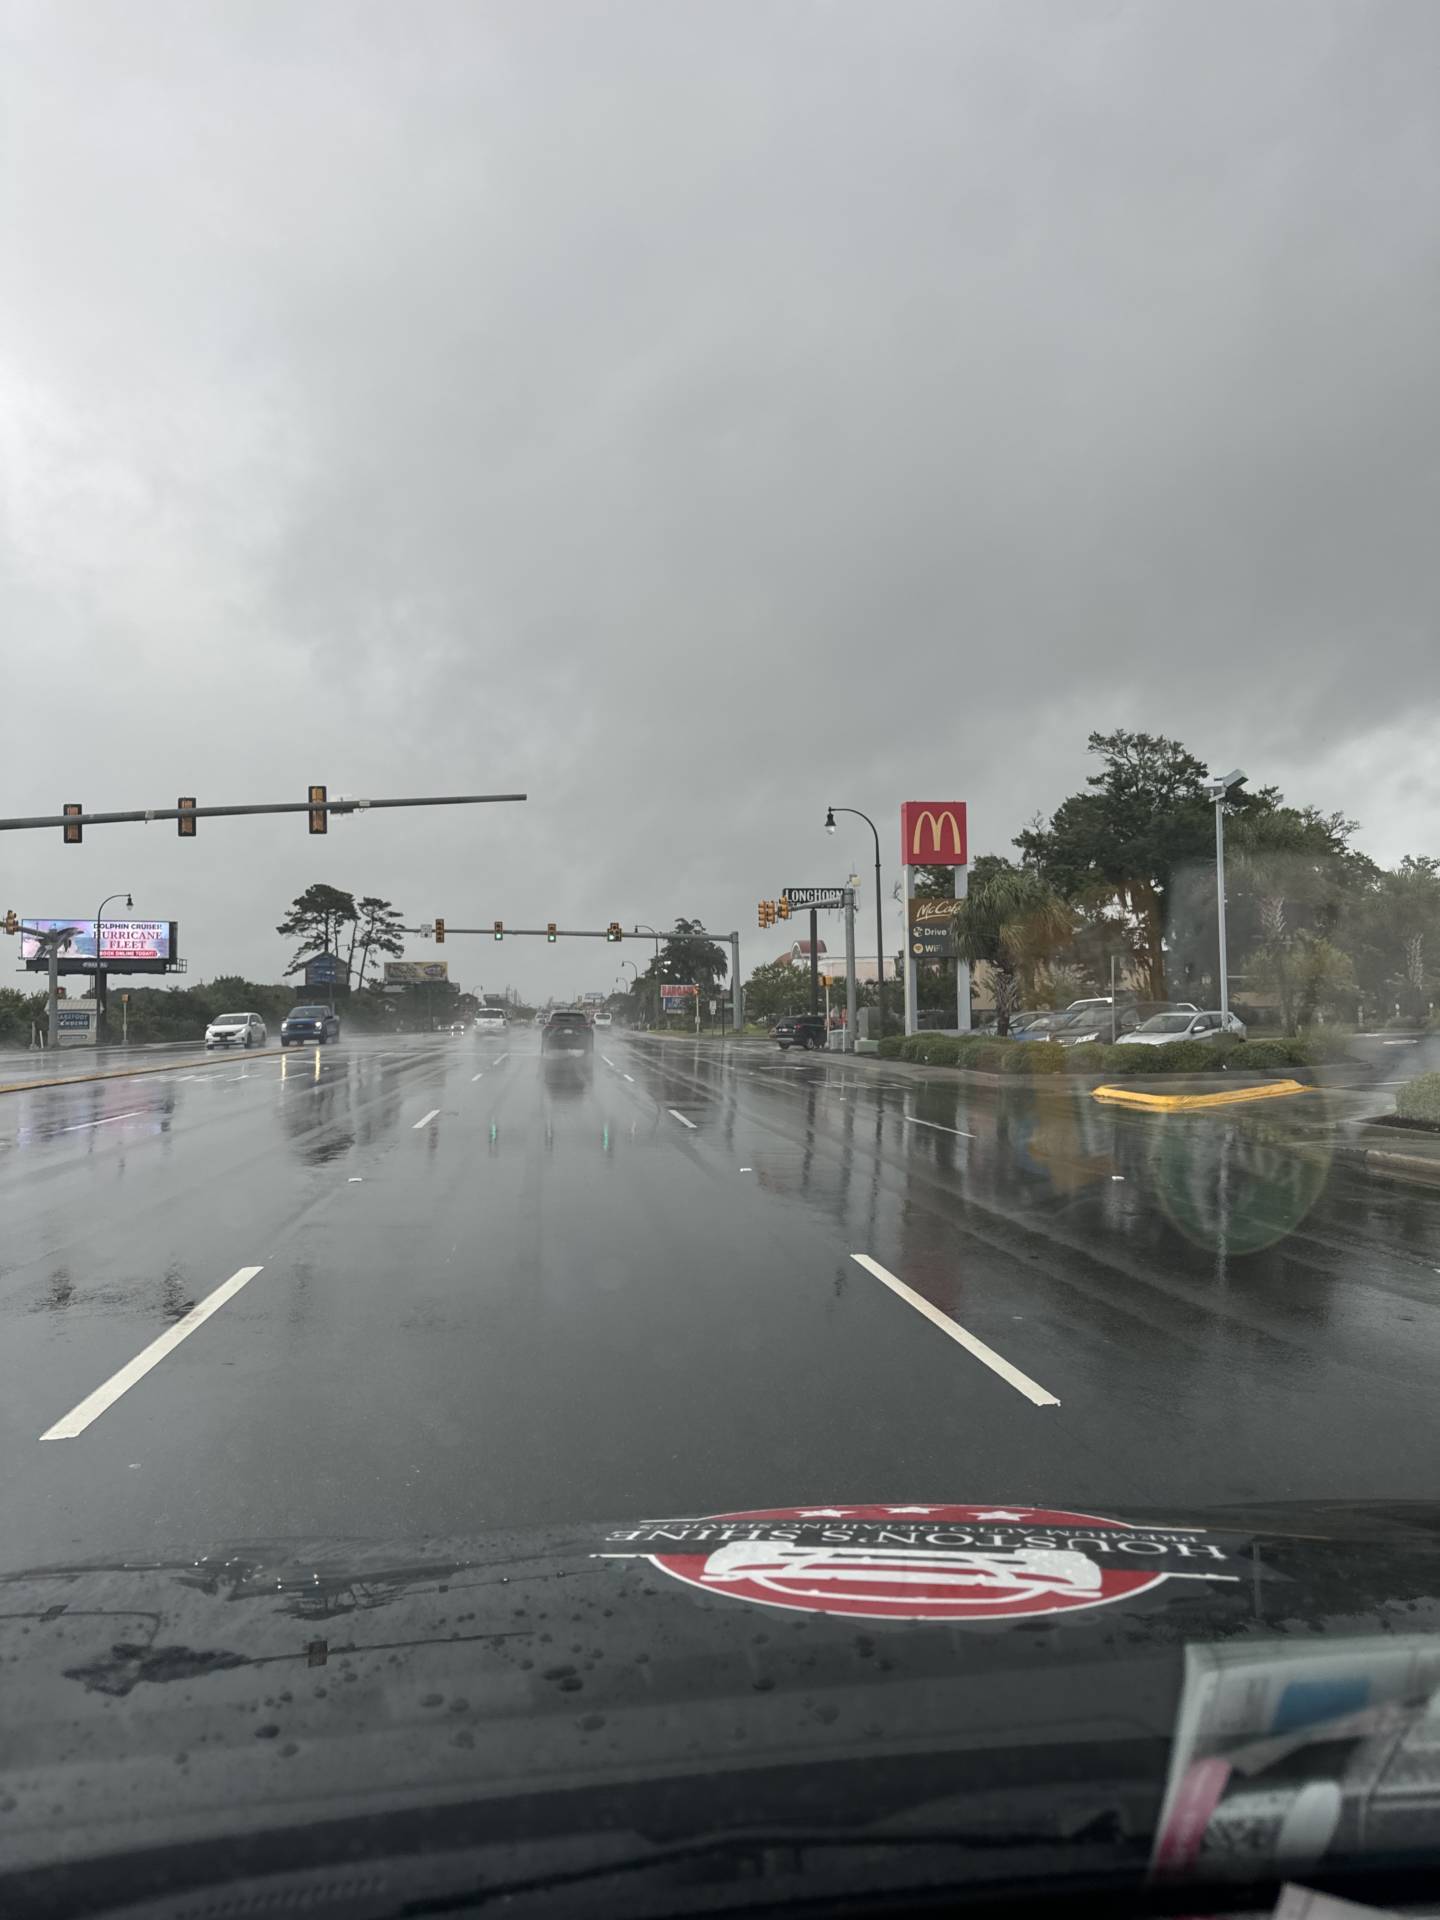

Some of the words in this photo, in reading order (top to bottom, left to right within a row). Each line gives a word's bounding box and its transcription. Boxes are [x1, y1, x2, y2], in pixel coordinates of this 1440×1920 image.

[785, 889, 843, 902] LONGHORN
[92, 931, 163, 940] HURRICANE
[924, 928, 947, 936] Drive
[110, 940, 146, 949] FLEET
[782, 1523, 939, 1532] DETAILING
[948, 1526, 1034, 1535] AUTO
[605, 1530, 801, 1541] SHINE
[1045, 1529, 1199, 1543] PREMIUM
[822, 1529, 1229, 1560] HOUSTON'S
